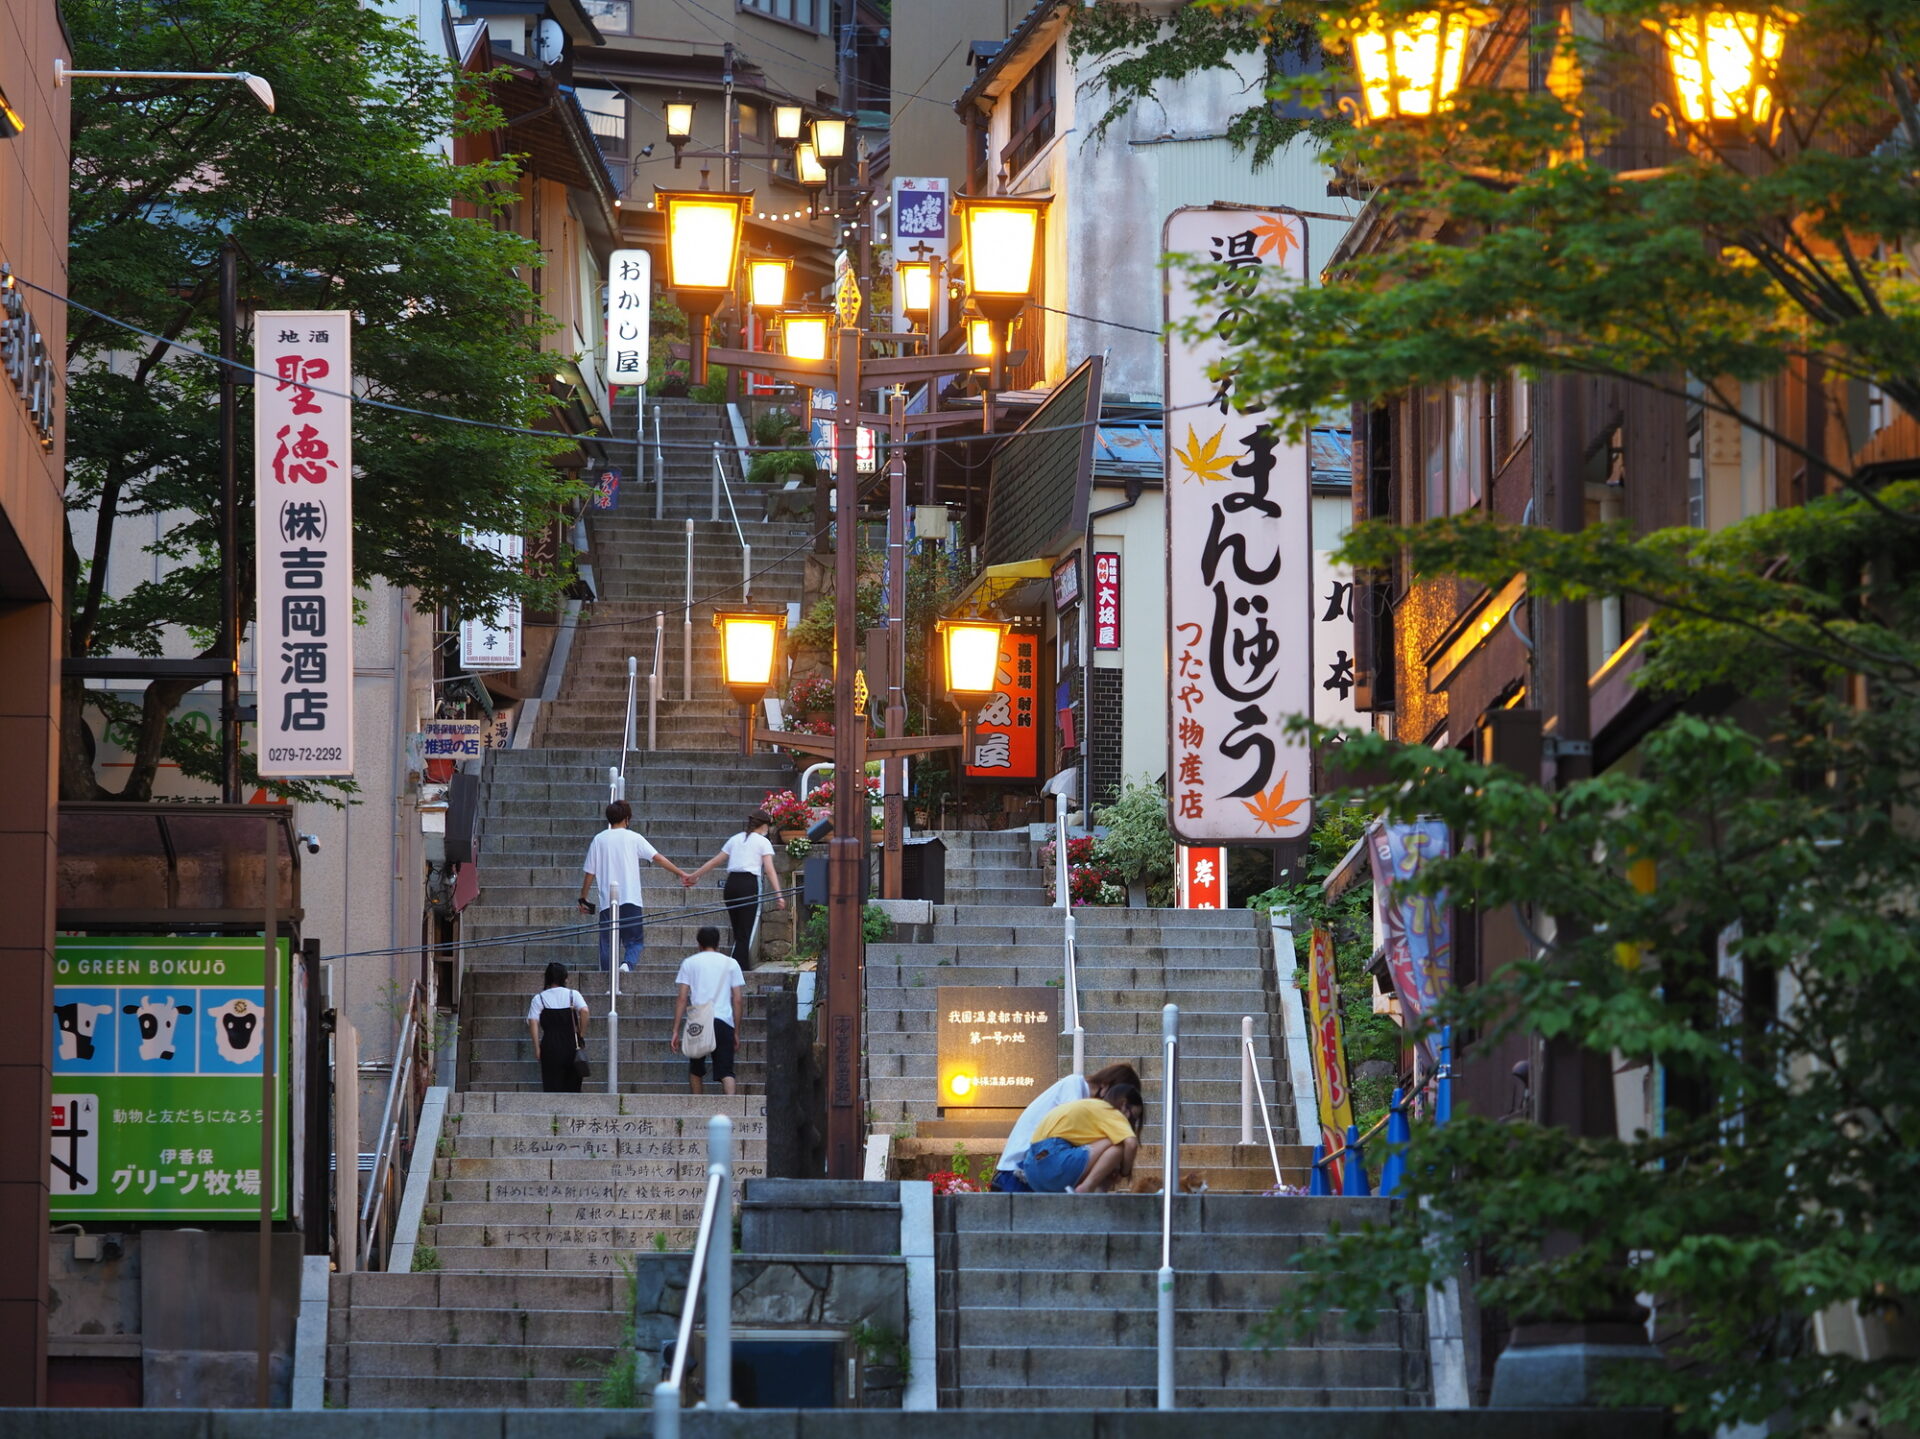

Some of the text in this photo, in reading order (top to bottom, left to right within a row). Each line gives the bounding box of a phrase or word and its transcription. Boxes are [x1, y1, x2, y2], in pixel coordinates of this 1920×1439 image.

[615, 259, 641, 373] おかし屋
[277, 329, 329, 344] 地酒
[272, 354, 338, 485] 聖徳
[1175, 621, 1206, 820] つたや物産店
[425, 723, 480, 736] 伊香保観光協会
[268, 746, 342, 763] 0279-72-2292
[424, 738, 480, 756] 推奨の店
[78, 959, 140, 975] GREEN
[948, 1010, 1049, 1024] 我国温泉都市計画
[969, 1031, 1026, 1046] 第一号の地
[159, 1148, 215, 1165] 伊香保
[111, 1163, 262, 1196] グリーン牧場
